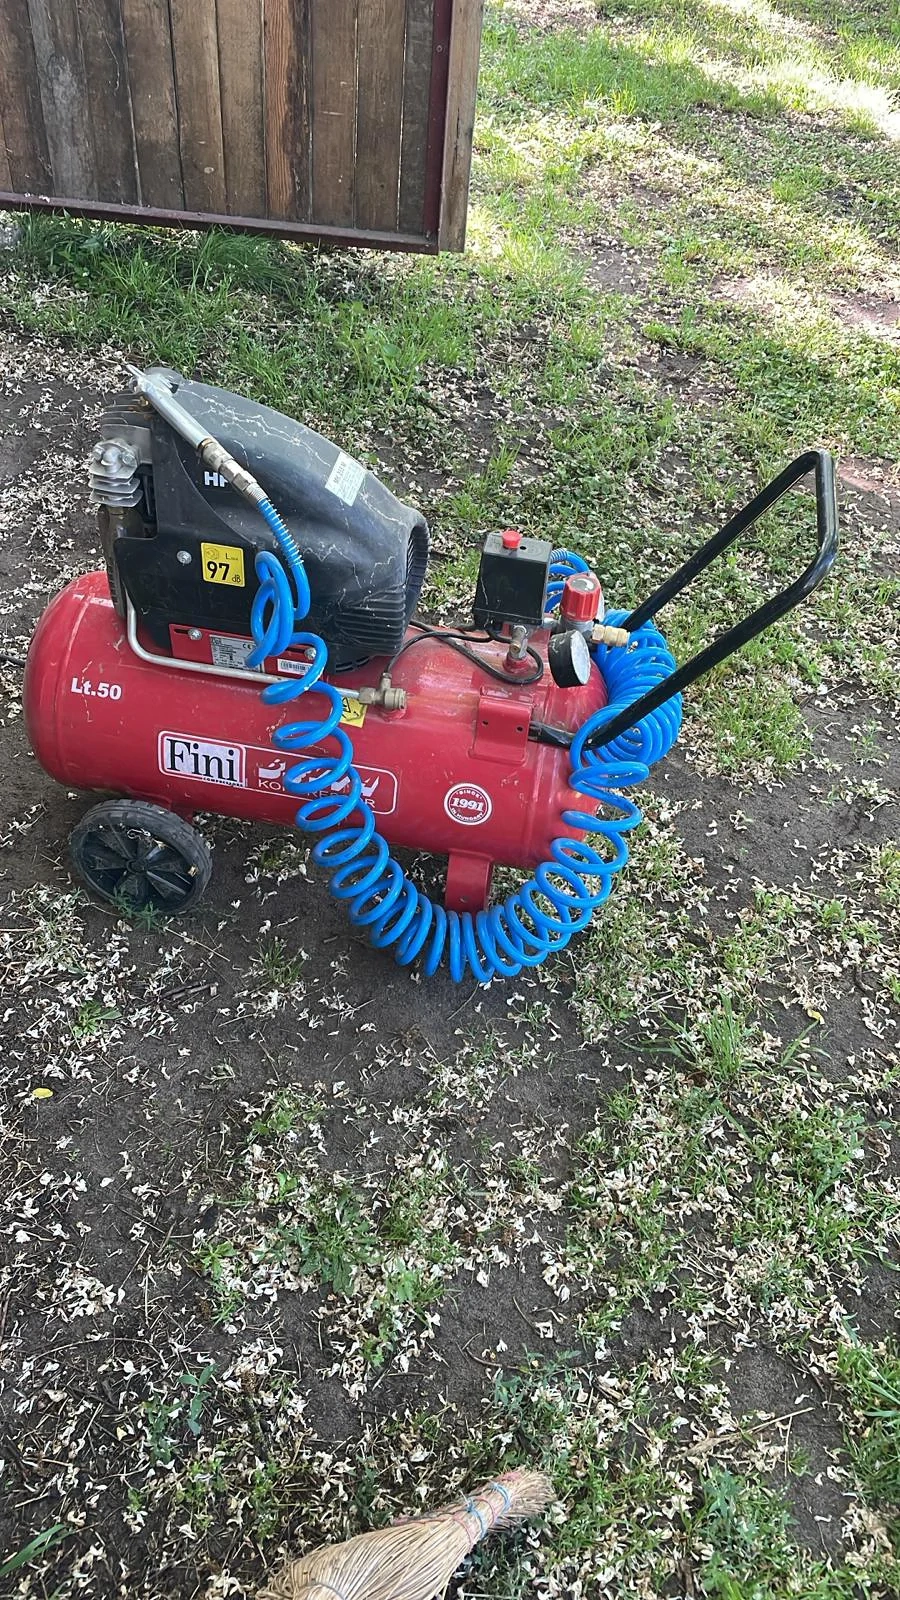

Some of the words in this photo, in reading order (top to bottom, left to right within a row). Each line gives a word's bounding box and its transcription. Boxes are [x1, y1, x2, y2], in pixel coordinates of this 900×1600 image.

[207, 561, 230, 581] 97
[231, 574, 241, 583] dB
[71, 677, 122, 700] Lt.50
[166, 738, 237, 782] Fini
[450, 797, 484, 812] 1991
